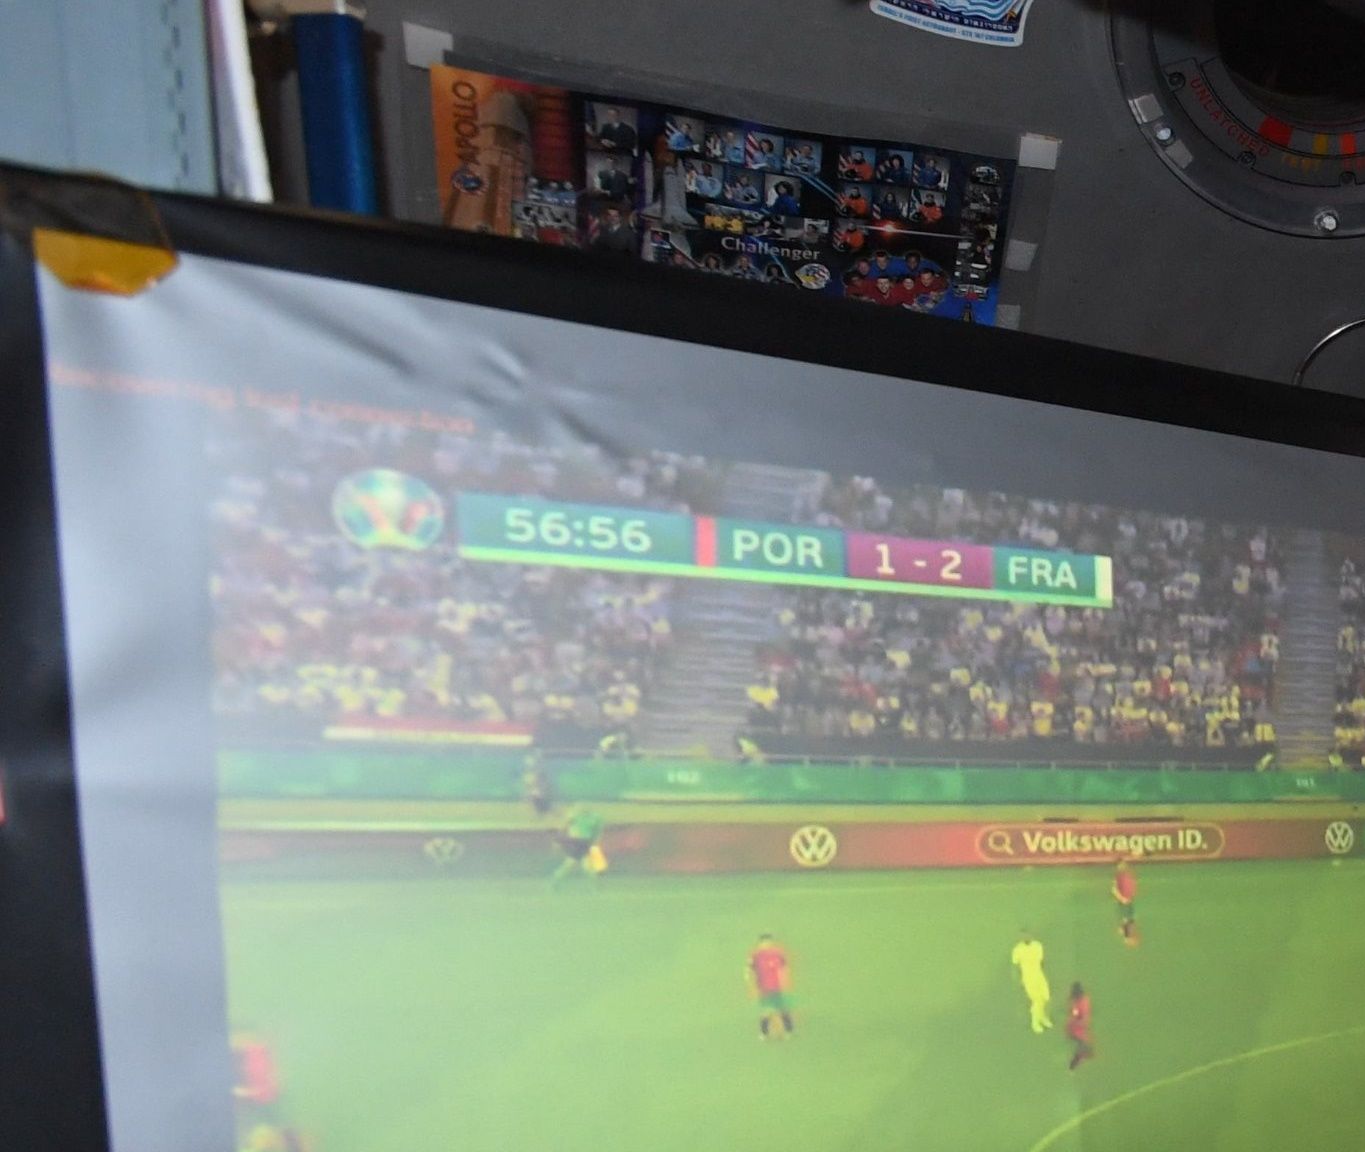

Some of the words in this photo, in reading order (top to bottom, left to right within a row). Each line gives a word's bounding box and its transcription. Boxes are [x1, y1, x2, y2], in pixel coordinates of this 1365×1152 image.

[452, 81, 479, 165] APOLLO
[1190, 77, 1271, 157] UNLATCHED
[721, 236, 821, 261] Challenger
[504, 508, 652, 552] 56:56
[733, 529, 823, 568] POR
[875, 543, 896, 576] 1
[940, 550, 963, 581] 2
[1008, 557, 1077, 590] FRA
[1023, 831, 1170, 858] Volkswagen
[1178, 829, 1208, 850] ID.
